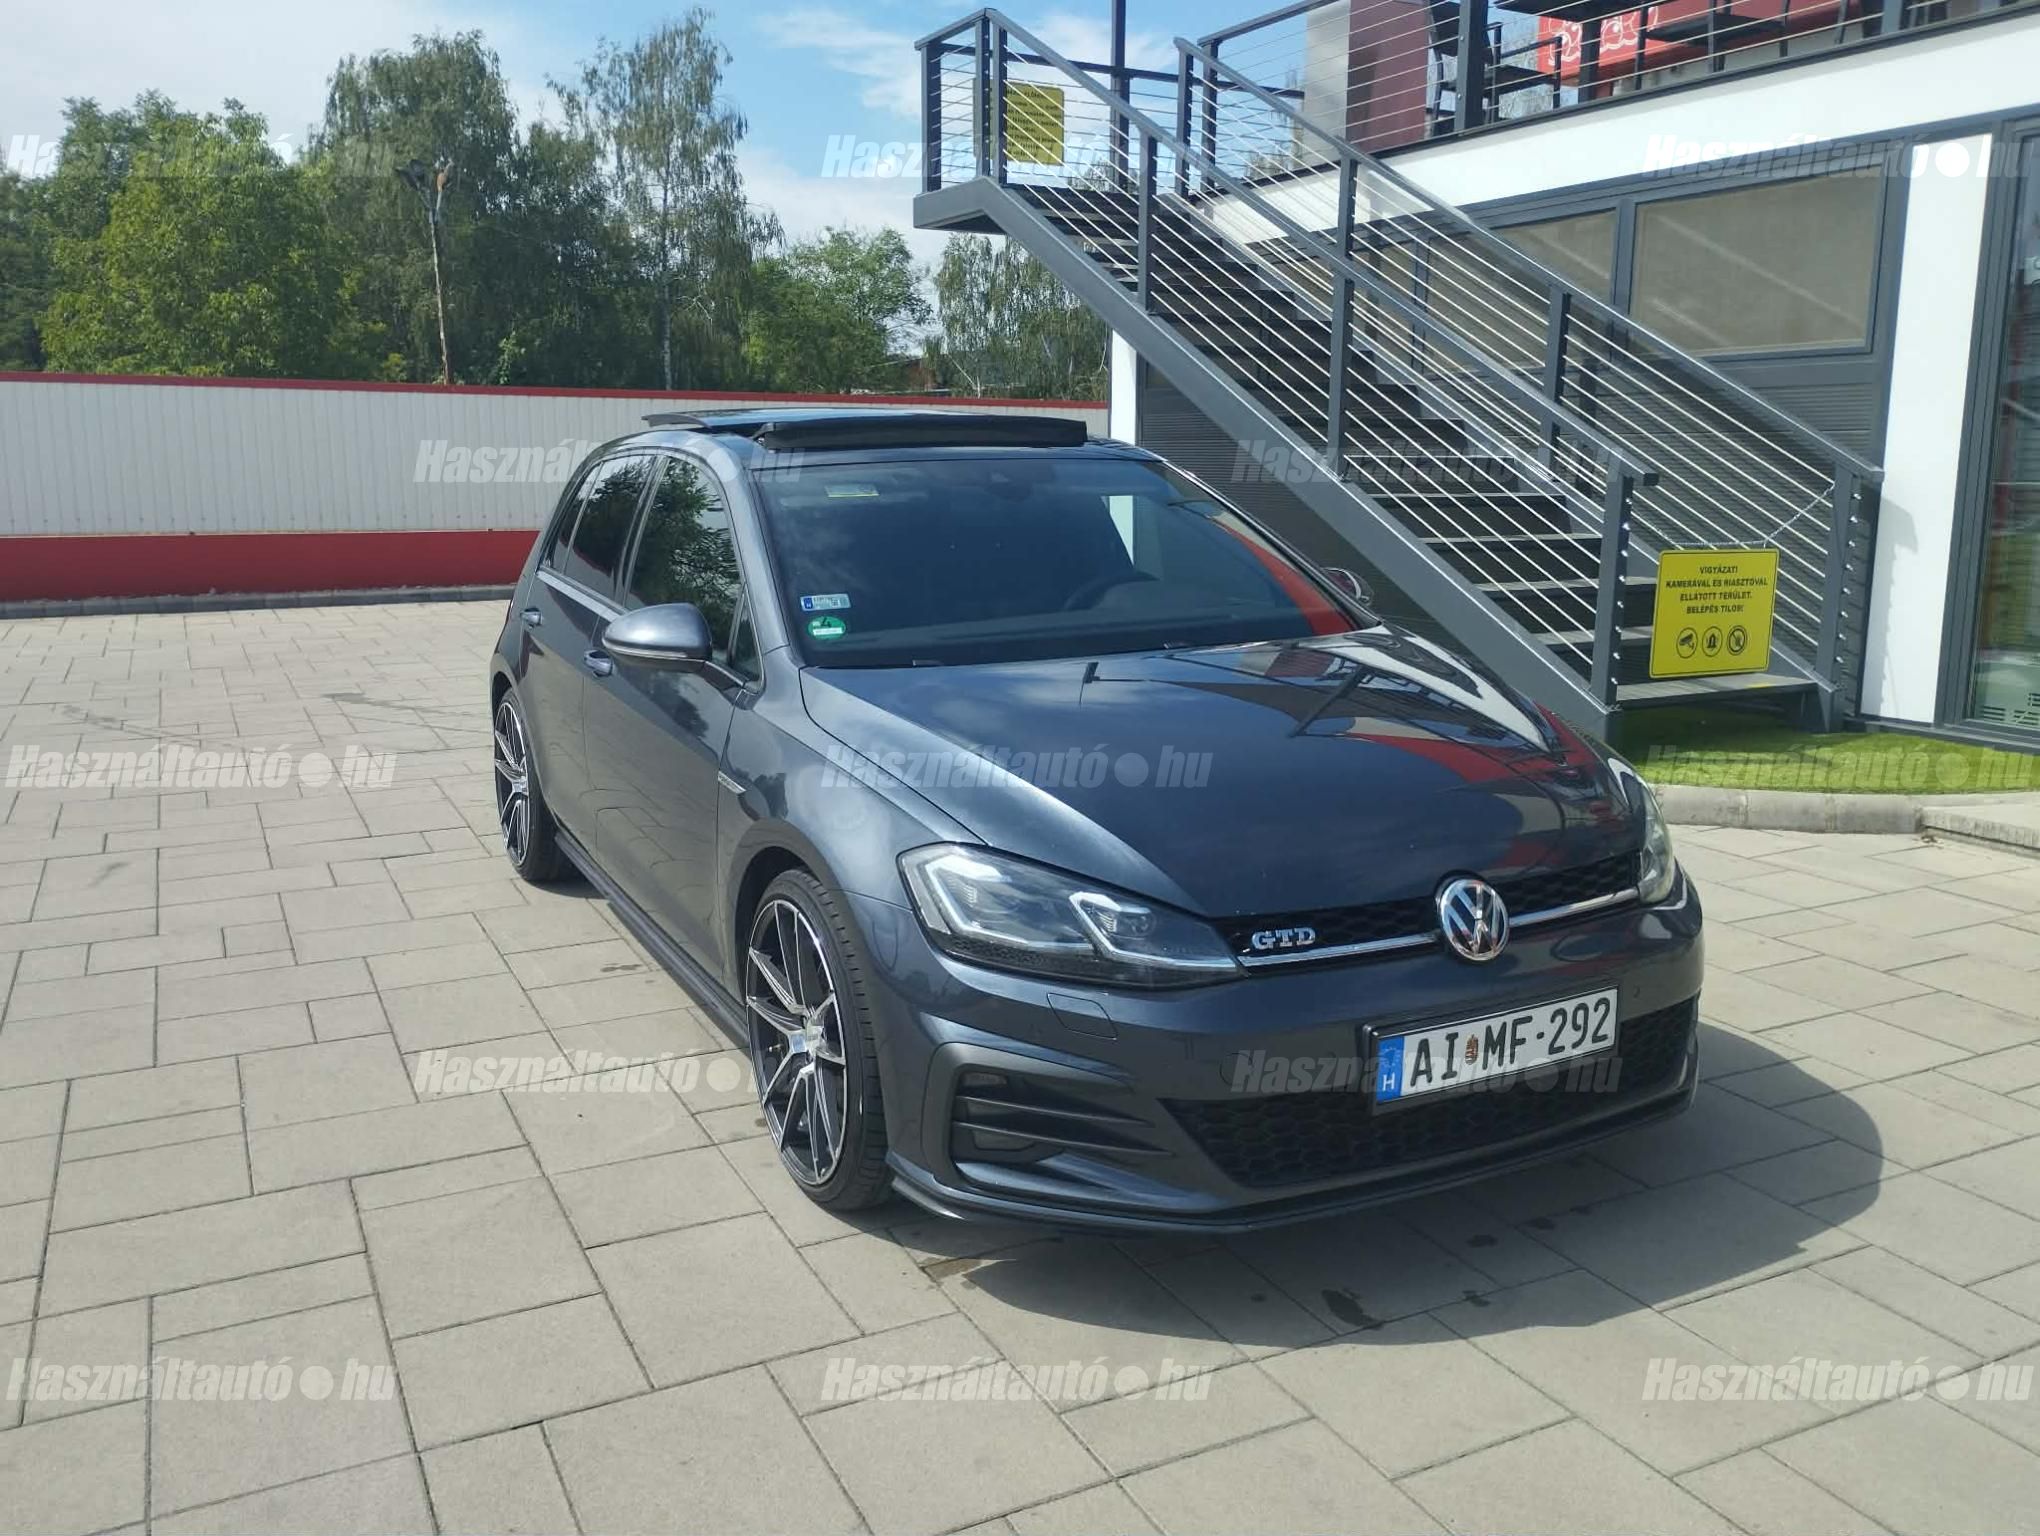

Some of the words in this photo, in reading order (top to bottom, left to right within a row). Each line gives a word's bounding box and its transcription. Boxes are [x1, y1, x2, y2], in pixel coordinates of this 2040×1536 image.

[1665, 579, 1711, 588] KAMERÁVAL
[1724, 577, 1768, 587] RIASZTÓVAL
[1680, 591, 1717, 601] ELLÁTOTT
[1686, 604, 1718, 614] BELÉPÉS
[1251, 927, 1316, 950] GTD
[1410, 1031, 1460, 1087] AI
[1481, 997, 1611, 1071] MF-292
[1382, 1073, 1396, 1092] H
